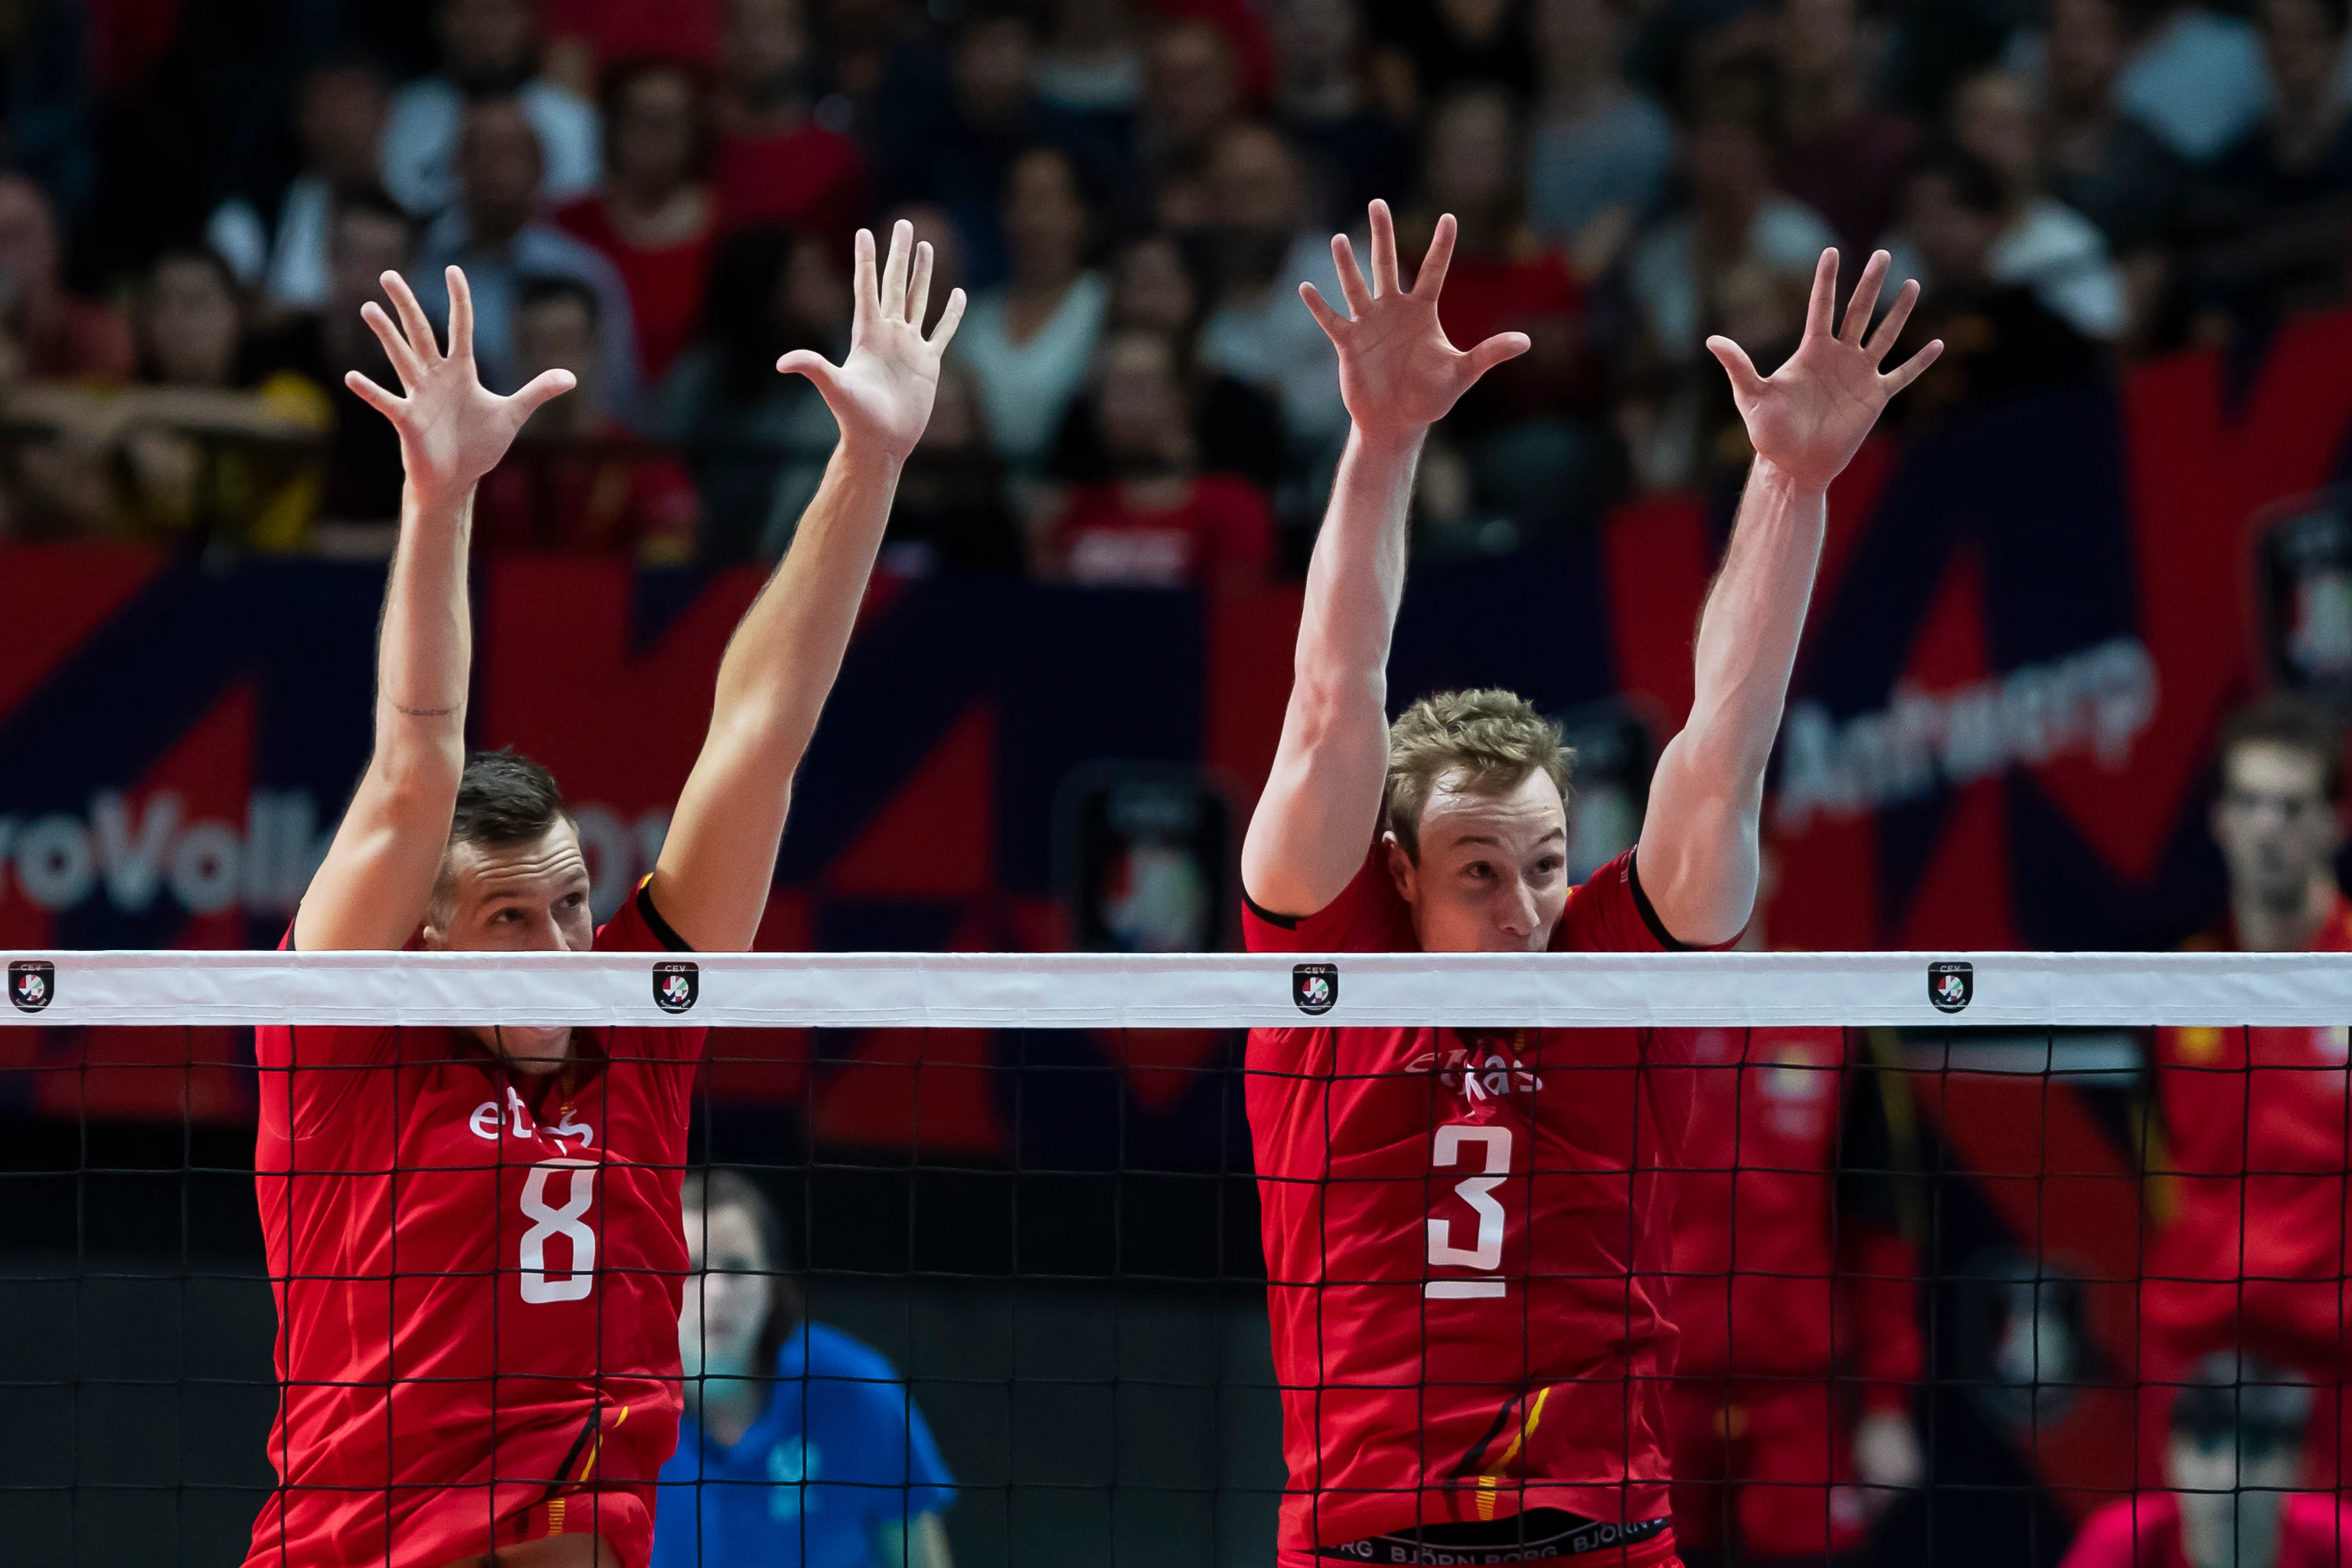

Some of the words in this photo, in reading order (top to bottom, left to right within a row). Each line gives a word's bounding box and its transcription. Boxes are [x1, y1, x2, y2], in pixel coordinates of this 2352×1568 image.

[665, 965, 686, 973] CEV
[520, 1158, 600, 1305] 8
[1428, 1125, 1512, 1271] 3
